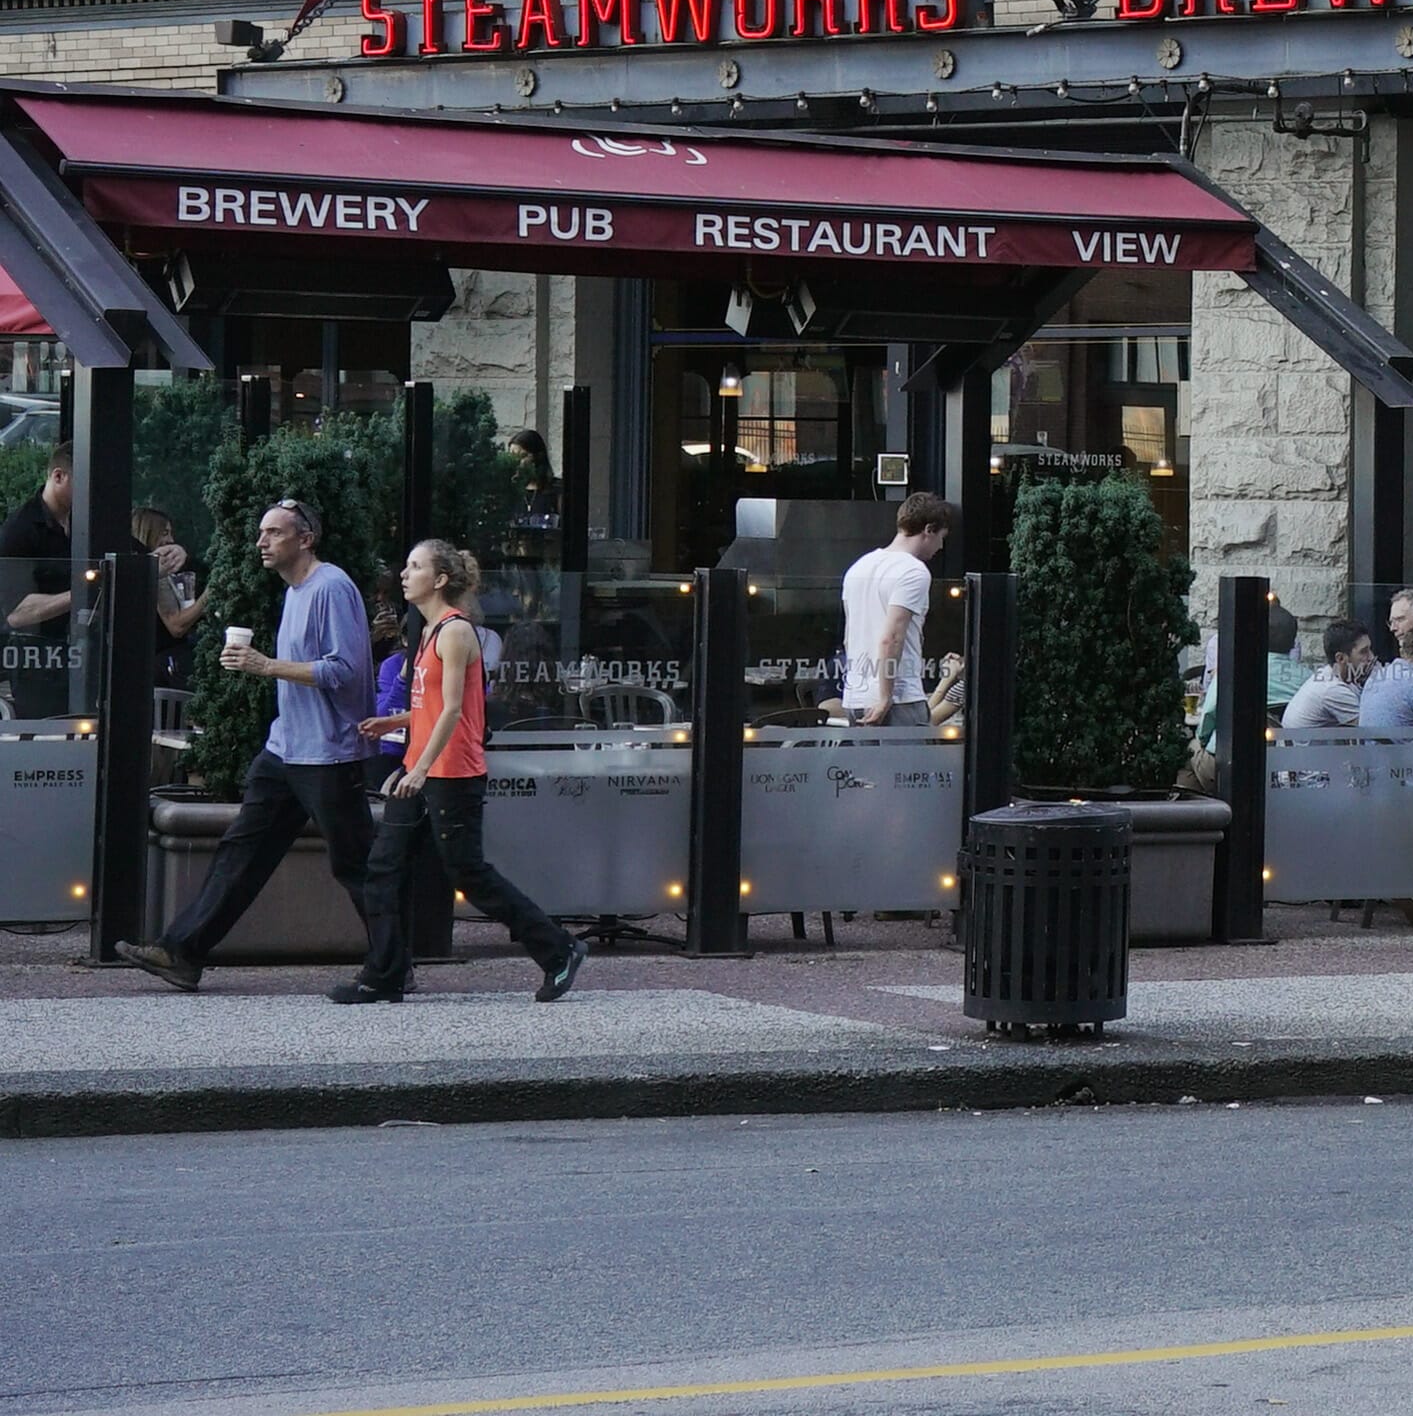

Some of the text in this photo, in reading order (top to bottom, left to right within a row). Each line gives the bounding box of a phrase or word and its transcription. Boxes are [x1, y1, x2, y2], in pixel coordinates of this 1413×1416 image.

[177, 186, 1181, 265] BREWERY PUB RESTAURANT VIEW
[1038, 454, 1122, 467] STEAMWORKS
[14, 770, 84, 781] EMPRESS
[607, 775, 681, 787] NIRVANA
[487, 778, 537, 790] ROICA
